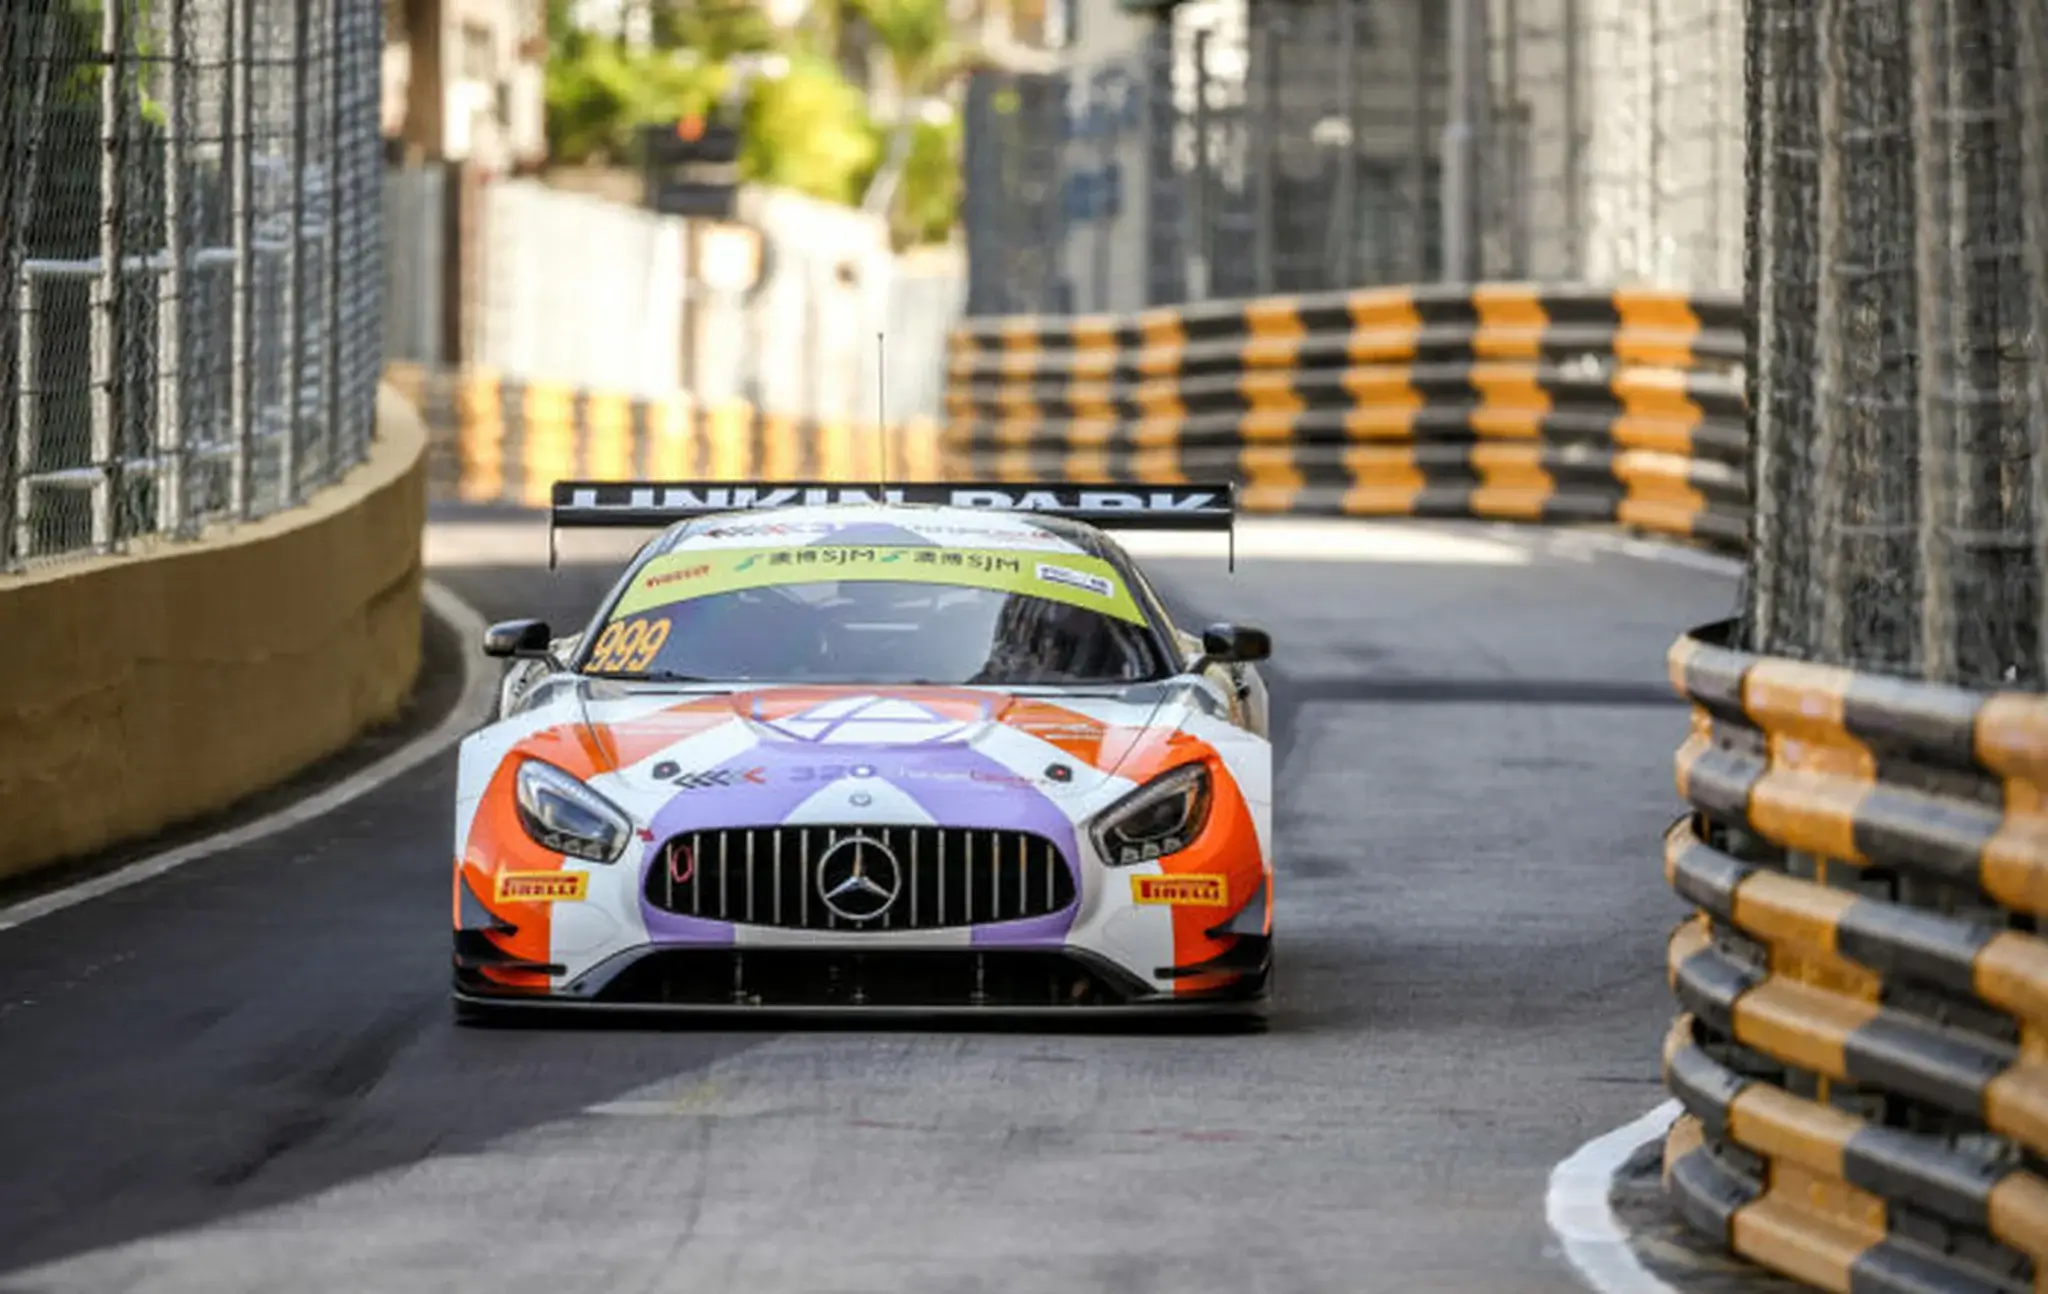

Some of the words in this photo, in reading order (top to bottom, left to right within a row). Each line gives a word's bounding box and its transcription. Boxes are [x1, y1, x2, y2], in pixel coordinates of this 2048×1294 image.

[584, 617, 672, 673] 999
[501, 876, 579, 897] PIRELLI
[1140, 880, 1220, 900] PIRELLI
